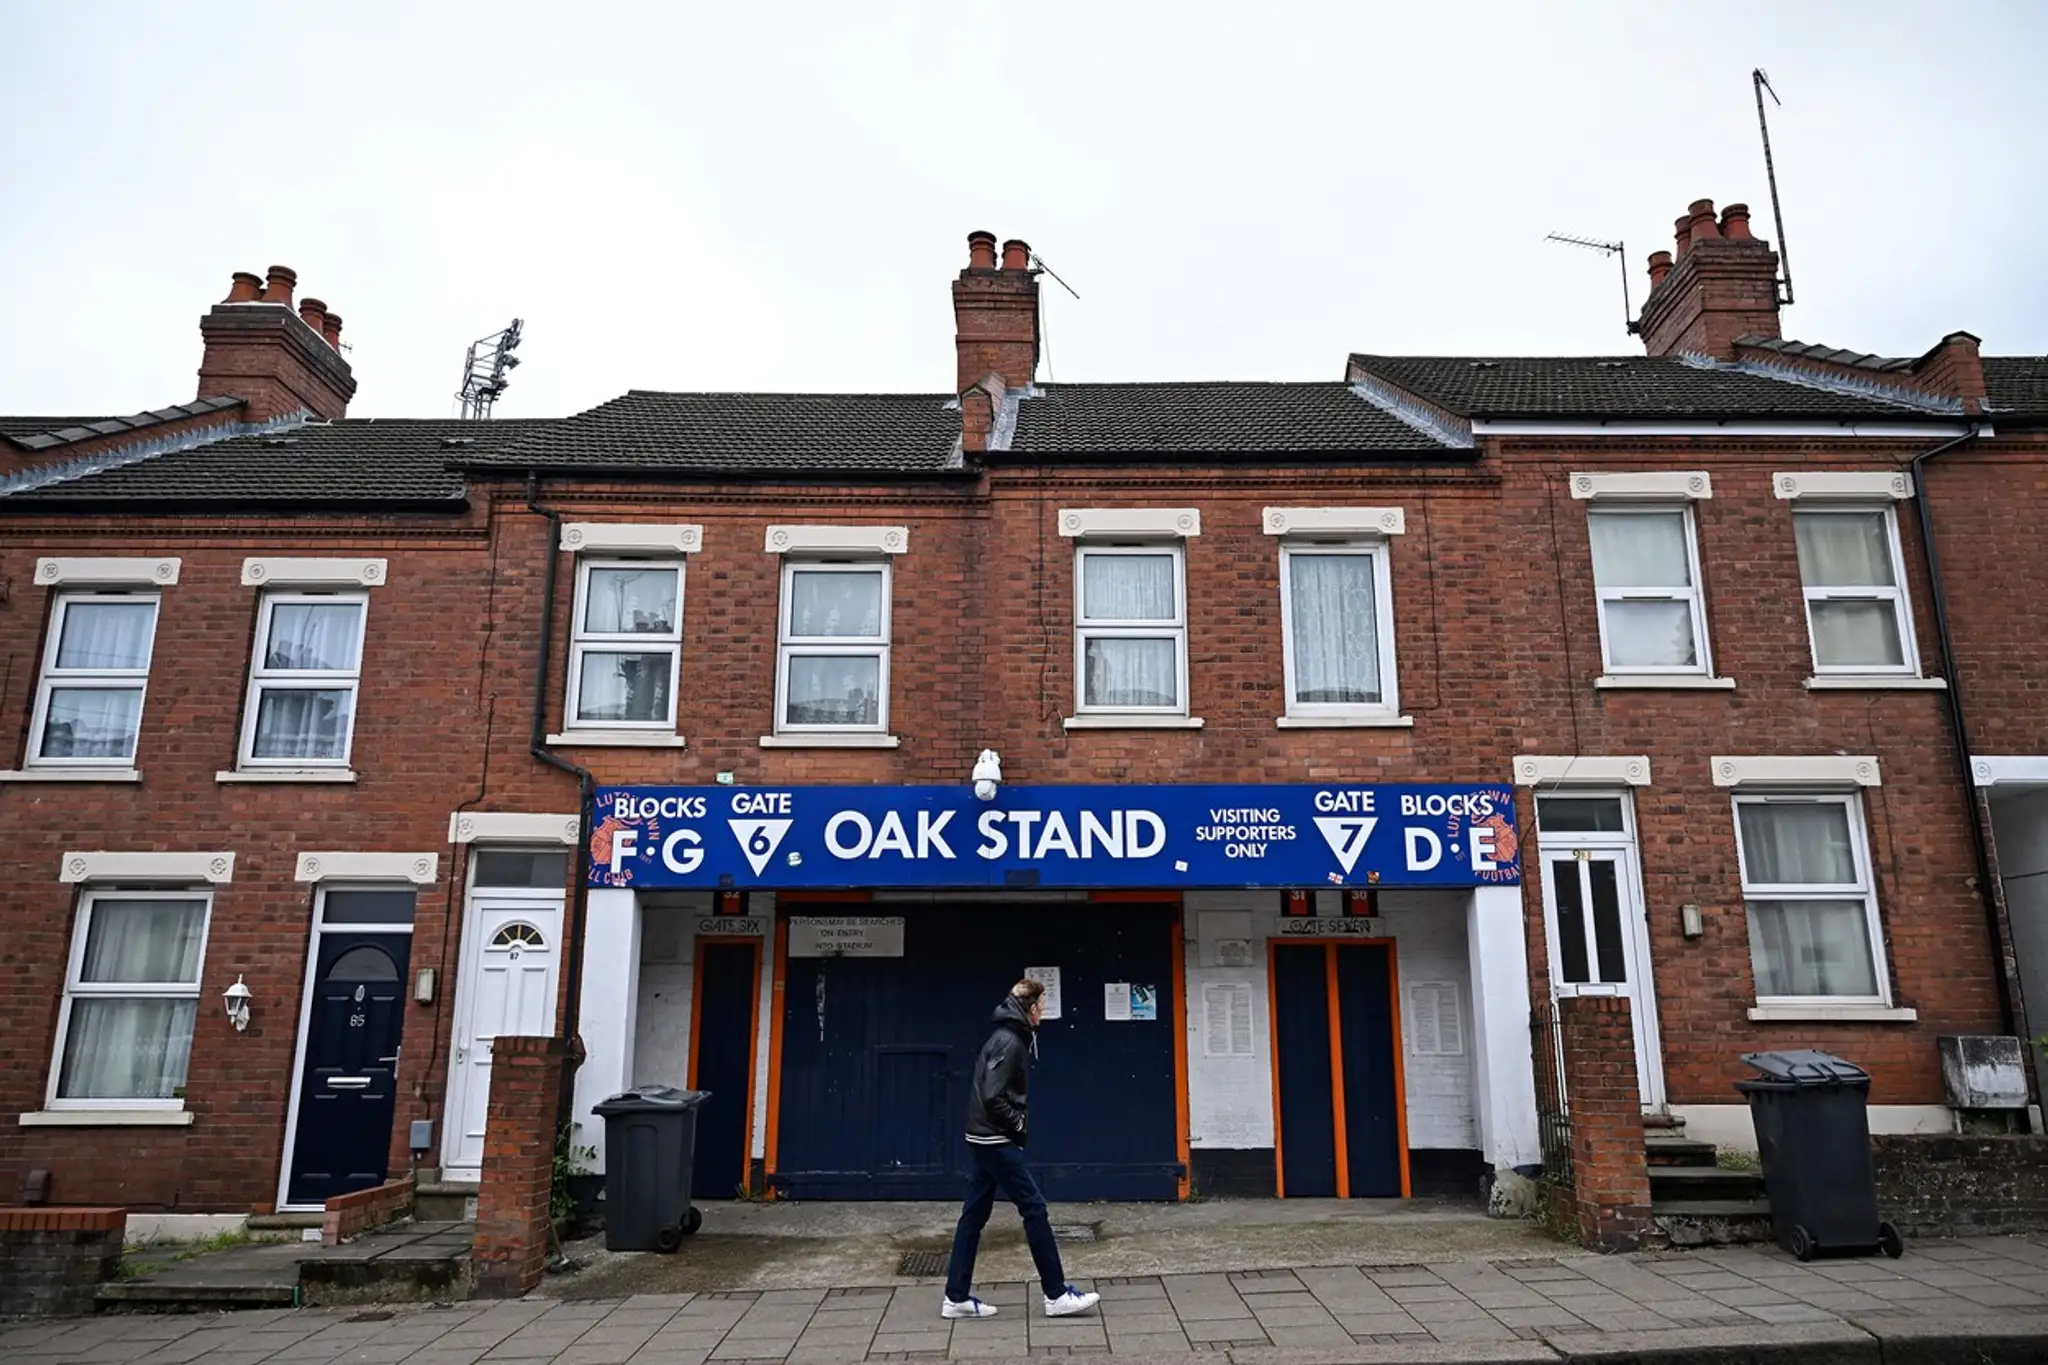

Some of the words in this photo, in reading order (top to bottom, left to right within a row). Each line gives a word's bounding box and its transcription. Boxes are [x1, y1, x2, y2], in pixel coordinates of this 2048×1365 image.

[614, 797, 706, 819] BLOCKS
[731, 793, 792, 814] GATE
[1315, 791, 1375, 812] GATE
[1401, 794, 1494, 816] BLOCKS
[1210, 809, 1281, 823] VISITING
[748, 823, 771, 856] 6
[824, 810, 957, 859] OAK
[976, 809, 1166, 859] STAND
[1196, 826, 1297, 841] SUPPORTERS
[1340, 823, 1360, 853] 7
[1225, 843, 1268, 858] ONLY
[1291, 890, 1306, 900] 31
[1352, 890, 1367, 900] 30
[699, 918, 735, 932] GATE
[739, 918, 761, 932] SIX
[820, 928, 834, 937] ON
[836, 928, 864, 937] ENTRY
[1288, 919, 1325, 933] GATE
[1327, 919, 1371, 933] SEVEN
